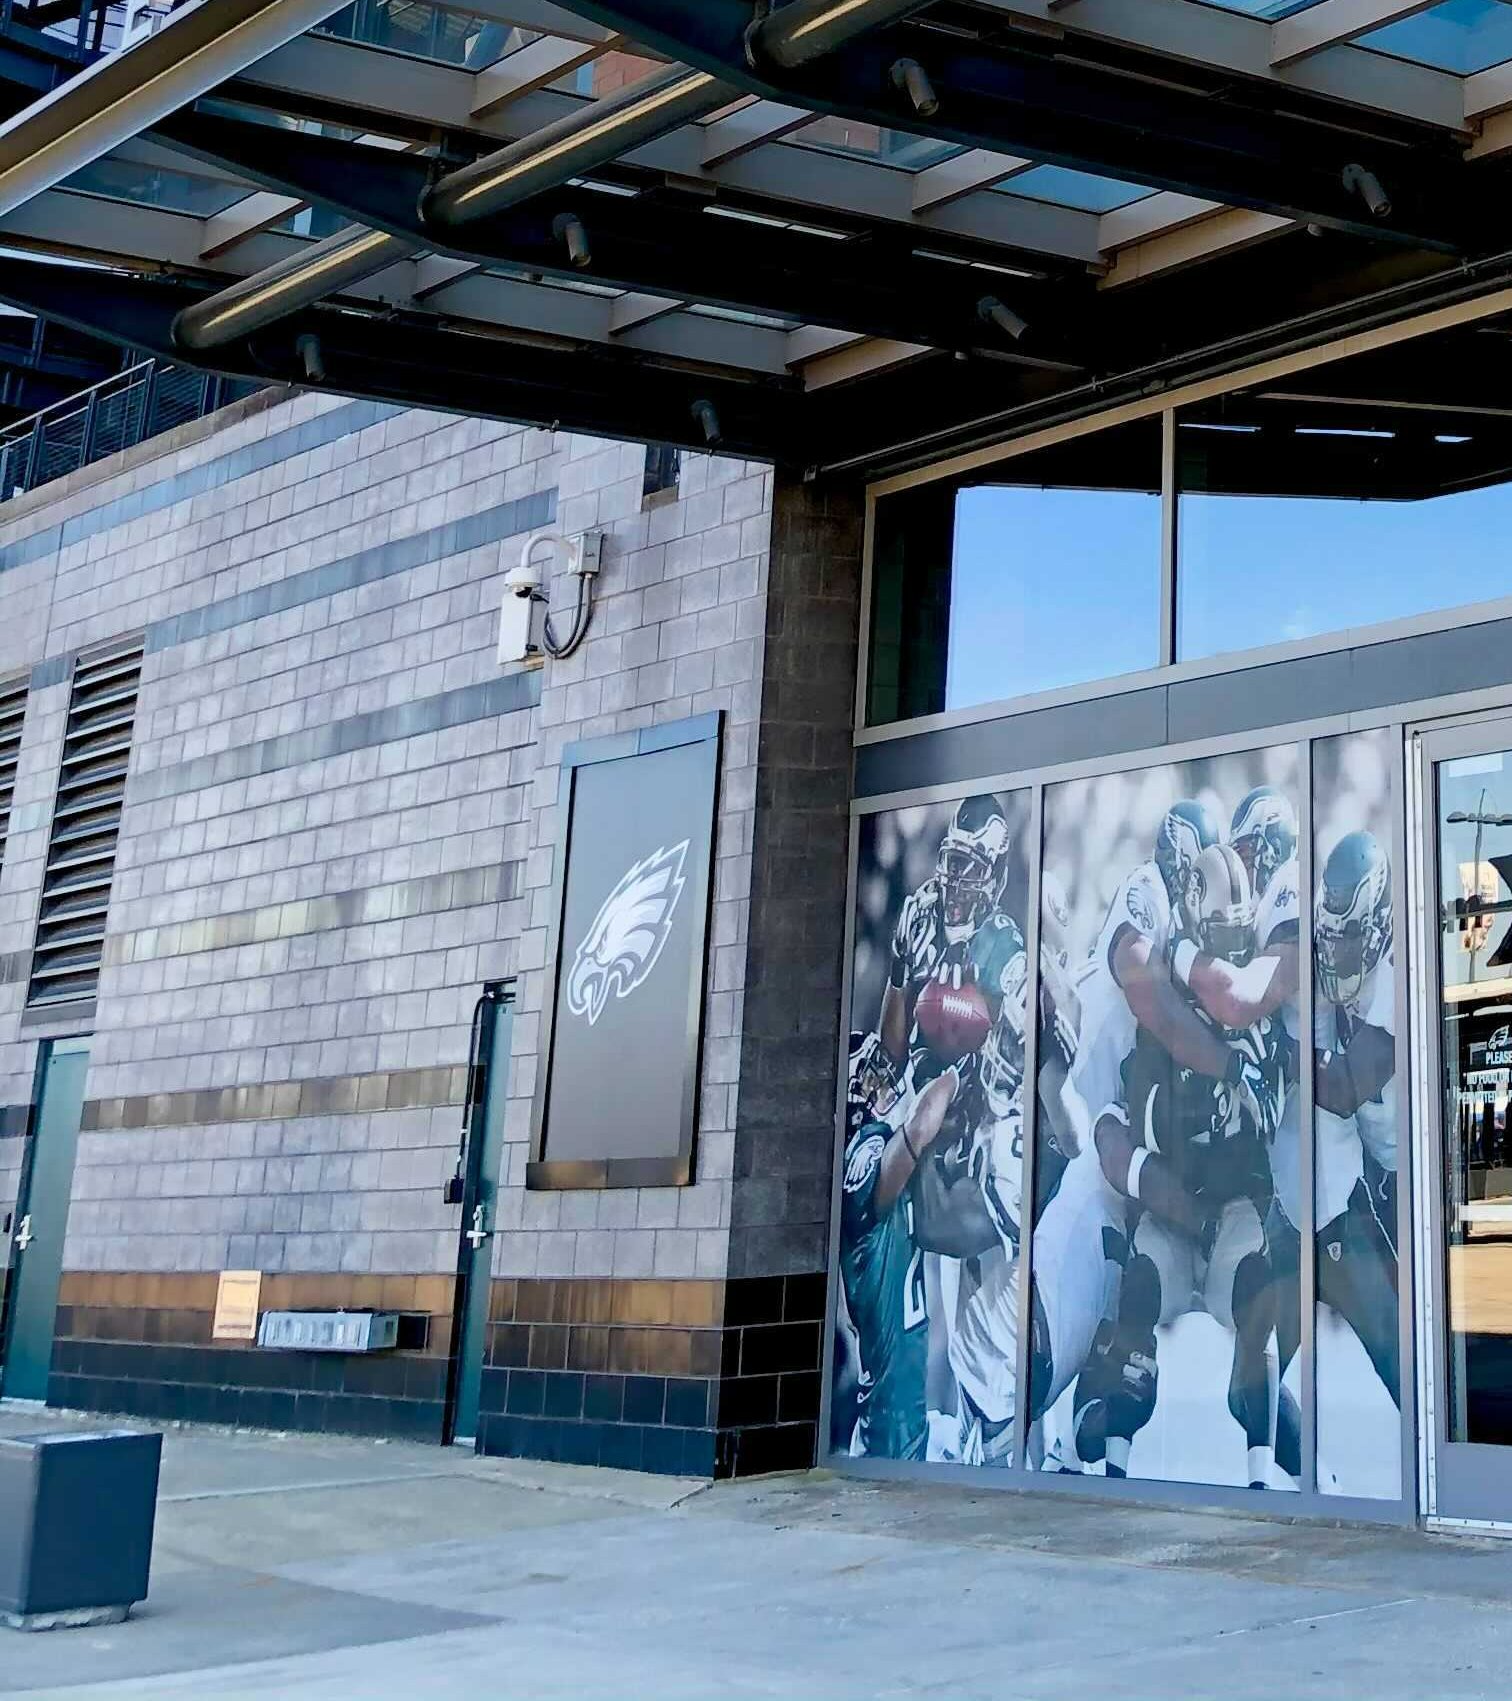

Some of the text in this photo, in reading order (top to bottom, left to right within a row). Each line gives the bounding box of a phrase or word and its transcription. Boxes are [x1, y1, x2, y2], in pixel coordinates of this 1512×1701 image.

[1486, 1051, 1512, 1064] PLEASE
[1467, 1070, 1477, 1085] NO
[1479, 1069, 1497, 1084] FOOD
